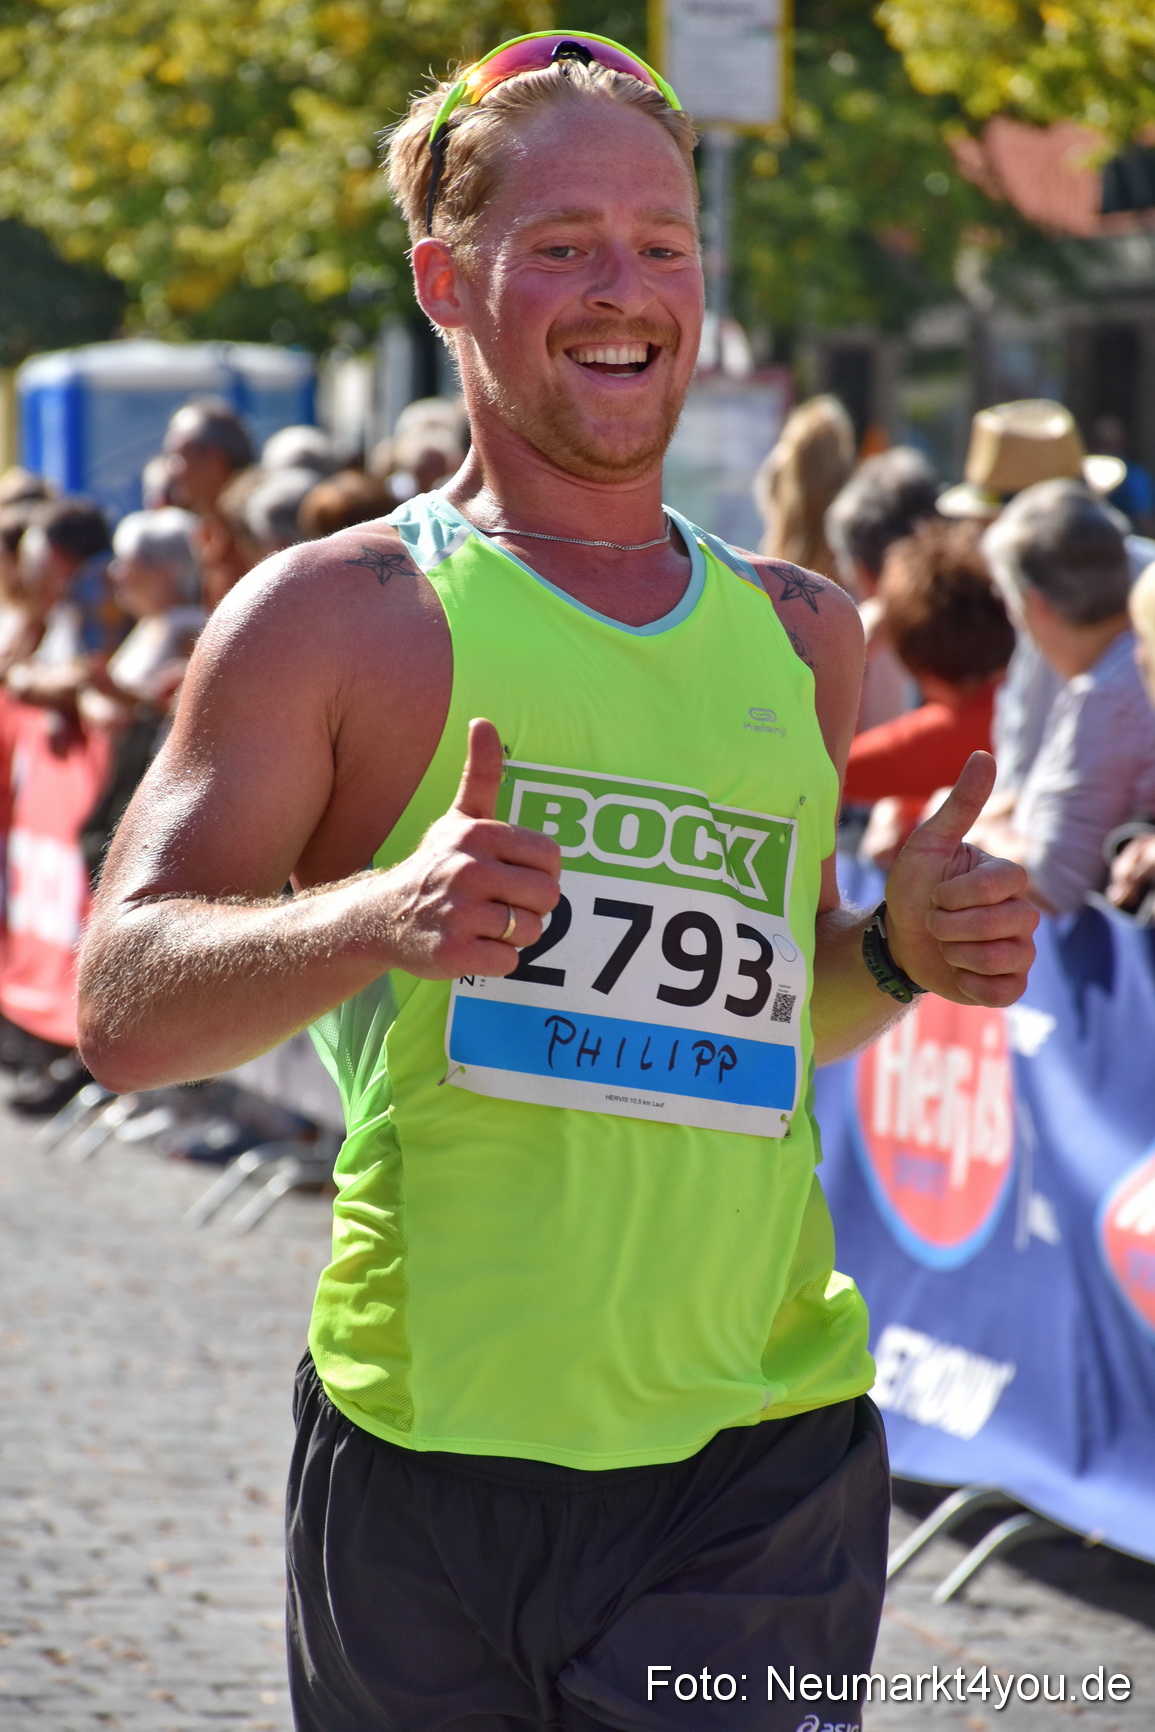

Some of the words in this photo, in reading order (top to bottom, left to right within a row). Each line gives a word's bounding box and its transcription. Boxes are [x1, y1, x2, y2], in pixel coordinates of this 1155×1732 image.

[511, 780, 769, 900] BOCK
[504, 891, 774, 1018] 2793
[545, 1015, 738, 1084] PHILIPP
[605, 1093, 629, 1104] HERVIS
[652, 1100, 665, 1108] Lauf
